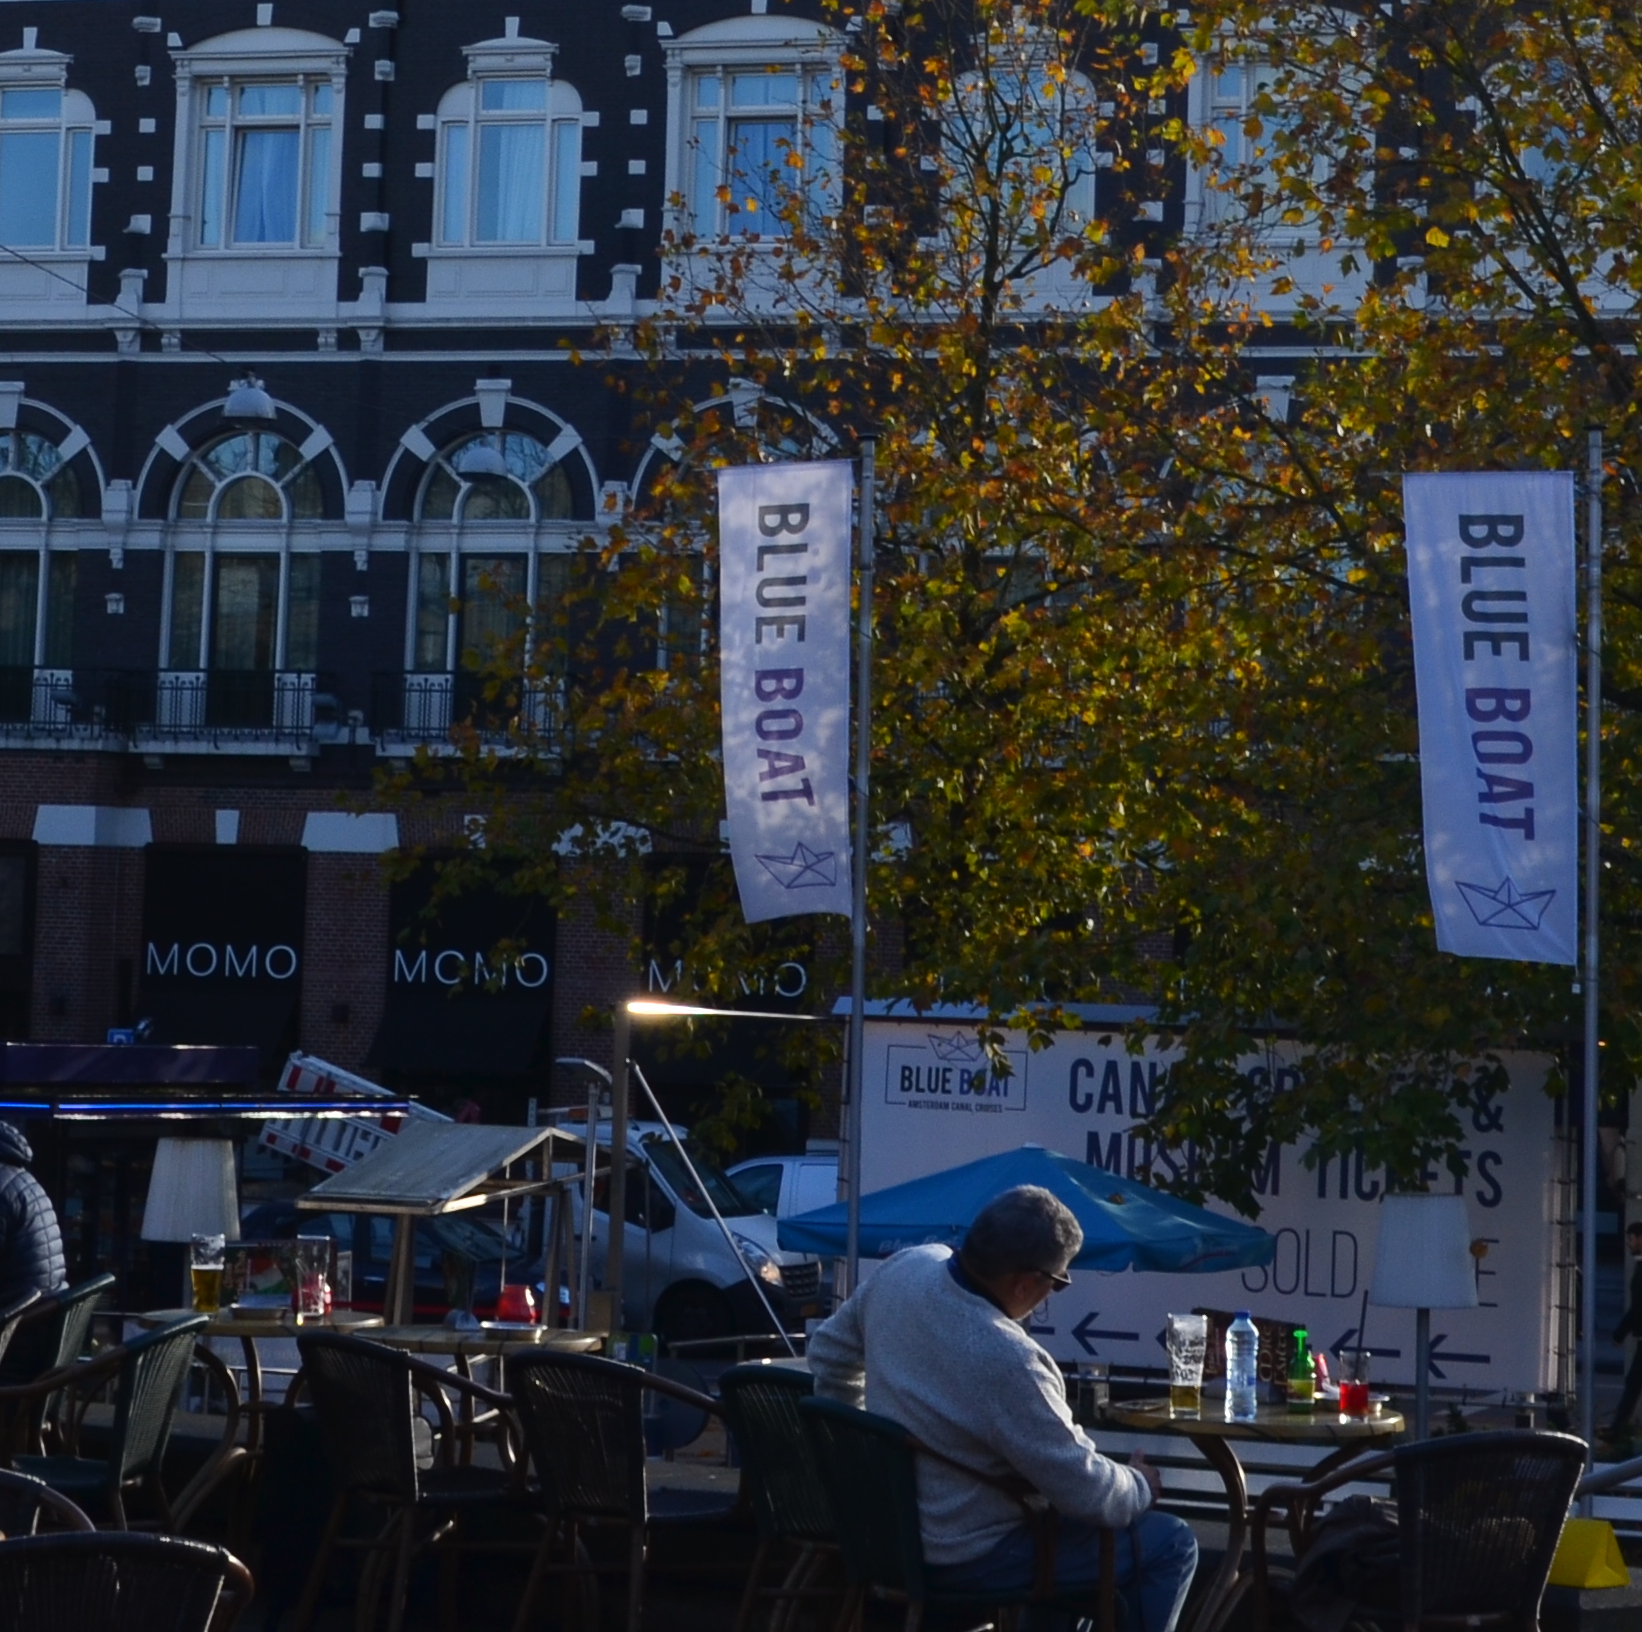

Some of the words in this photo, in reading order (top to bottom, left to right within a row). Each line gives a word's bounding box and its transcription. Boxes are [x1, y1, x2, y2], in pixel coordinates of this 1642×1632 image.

[755, 502, 810, 645] BLUE
[1458, 514, 1530, 662] BLUE
[754, 667, 815, 807] BOAT
[1465, 687, 1535, 841] BOAT
[146, 941, 298, 980] MOMO
[393, 948, 549, 989] MOMO
[648, 958, 807, 998] MMO
[900, 1065, 953, 1095] BLUE
[1069, 1057, 1179, 1116] CAN
